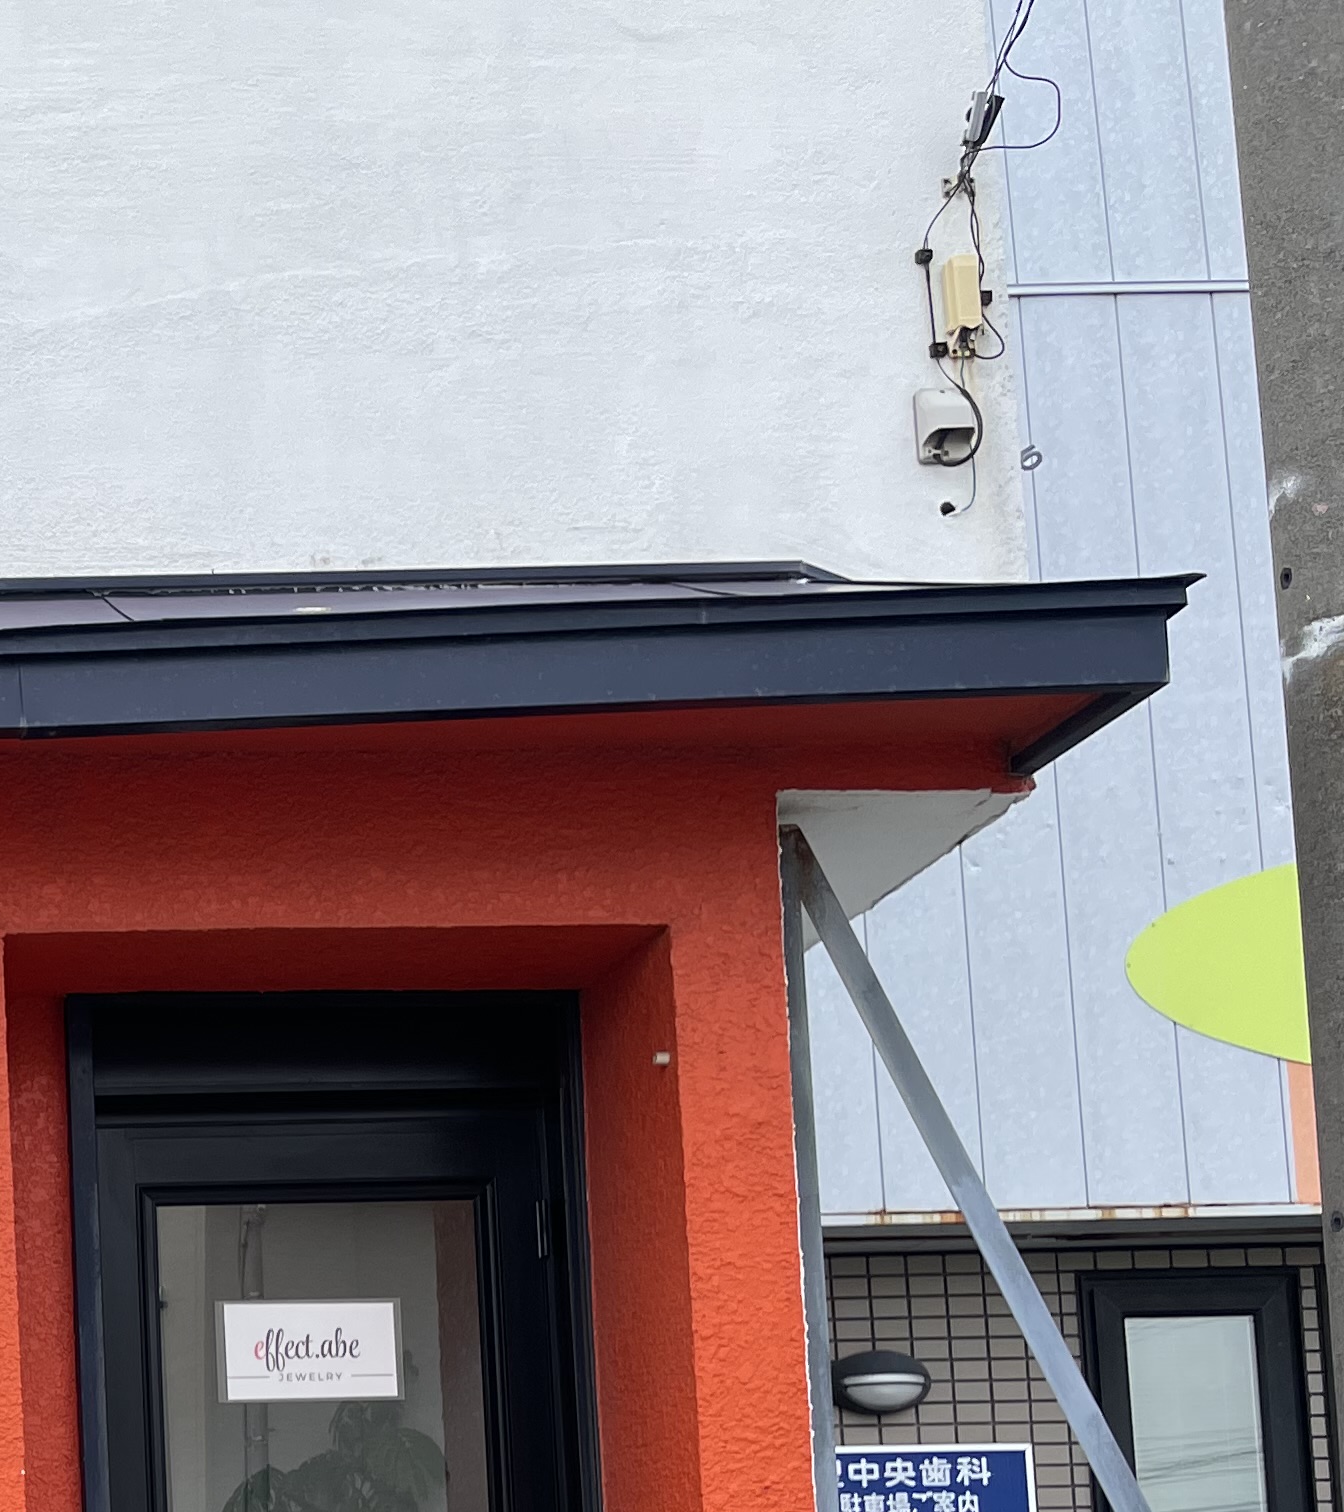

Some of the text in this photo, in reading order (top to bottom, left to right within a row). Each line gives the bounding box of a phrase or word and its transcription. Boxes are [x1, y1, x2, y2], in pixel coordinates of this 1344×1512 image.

[254, 1327, 360, 1372] effect.abe
[278, 1371, 343, 1382] JEWELRY
[836, 1456, 991, 1488] 中央歯科
